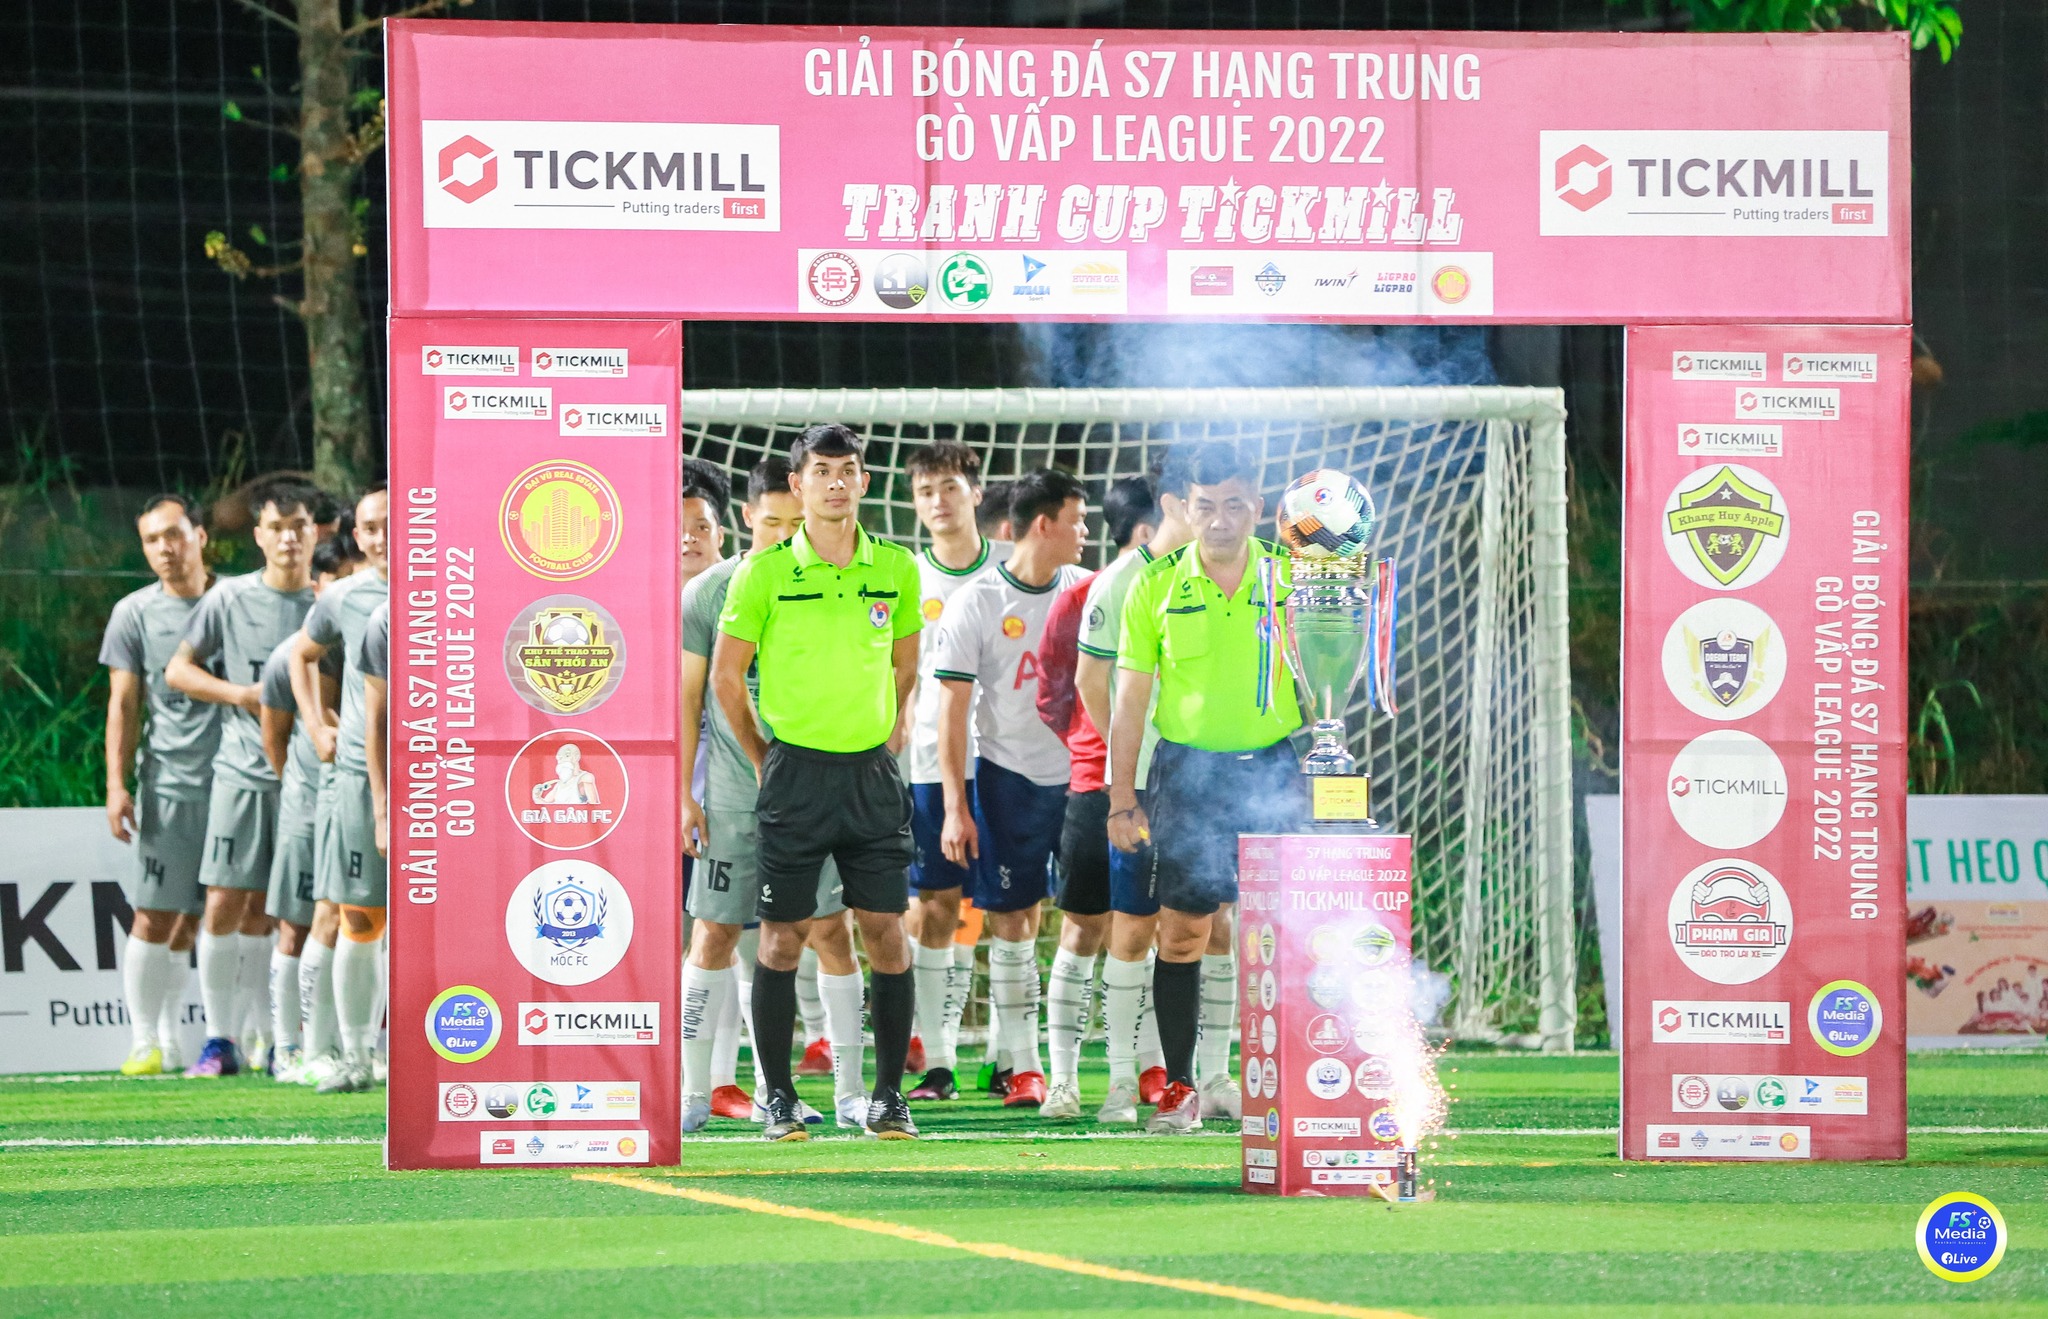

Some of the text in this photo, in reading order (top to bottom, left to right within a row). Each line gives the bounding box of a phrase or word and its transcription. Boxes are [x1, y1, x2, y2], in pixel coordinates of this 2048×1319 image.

[804, 35, 1481, 108] GIẢI BÓNG ĐÁ S7 HẠNG TRUNG
[916, 96, 1385, 164] GÒ VẤP LEAGUE 2022
[513, 149, 765, 193] TICKMILL
[1628, 158, 1874, 198] TICKMILL
[622, 201, 758, 216] Putting traders first
[842, 183, 1047, 242] TRANH
[1056, 184, 1167, 244] CUP
[1733, 207, 1866, 222] Putting traders first
[447, 354, 514, 365] TICKMILL
[556, 355, 623, 367] TICKMILL
[1696, 359, 1762, 371] TICKMILL
[1807, 360, 1873, 372] TICKMILL
[472, 395, 547, 408] TICKMILL
[1762, 396, 1836, 409] TICKMILL
[586, 413, 662, 425] TICKMILL
[1705, 432, 1778, 445] TICKMILL
[554, 471, 574, 479] REAL
[575, 474, 601, 495] ESTATE
[1678, 511, 1774, 528] Khang Huy Apple
[528, 551, 594, 570] FOOTBALL CLUB
[588, 658, 608, 667] AN
[401, 487, 443, 905] GIẢI BÓNG ĐÁ S7 HẠNG TRUNG
[435, 547, 475, 837] GÒ VẤP LEAGUE 2022
[1814, 576, 1853, 860] GÒ VẤP LEAGUE 2022
[1845, 510, 1888, 920] GIẢI BÓNG ĐÁ S7 HẠNG TRUNG
[1694, 779, 1785, 795] TICKMILL
[592, 809, 612, 824] FC
[212, 836, 235, 865] 17
[1356, 847, 1392, 859] TRUNG
[349, 851, 363, 878] 8
[1947, 839, 2020, 884] HEO
[144, 857, 165, 887] 14
[708, 858, 733, 892] 16
[1333, 869, 1375, 882] LEAGUE
[1377, 869, 1407, 882] 2022
[1289, 890, 1410, 911] TICKMILL CUP
[1692, 928, 1770, 944] PHẠM GIA
[576, 956, 588, 966] FC
[50, 1000, 131, 1026] Putti
[1687, 1012, 1784, 1028] TICKMILL
[1823, 1010, 1866, 1020] Media
[441, 1016, 485, 1027] Media
[554, 1014, 653, 1029] TICKMILL
[1311, 1122, 1358, 1130] TICKMILL
